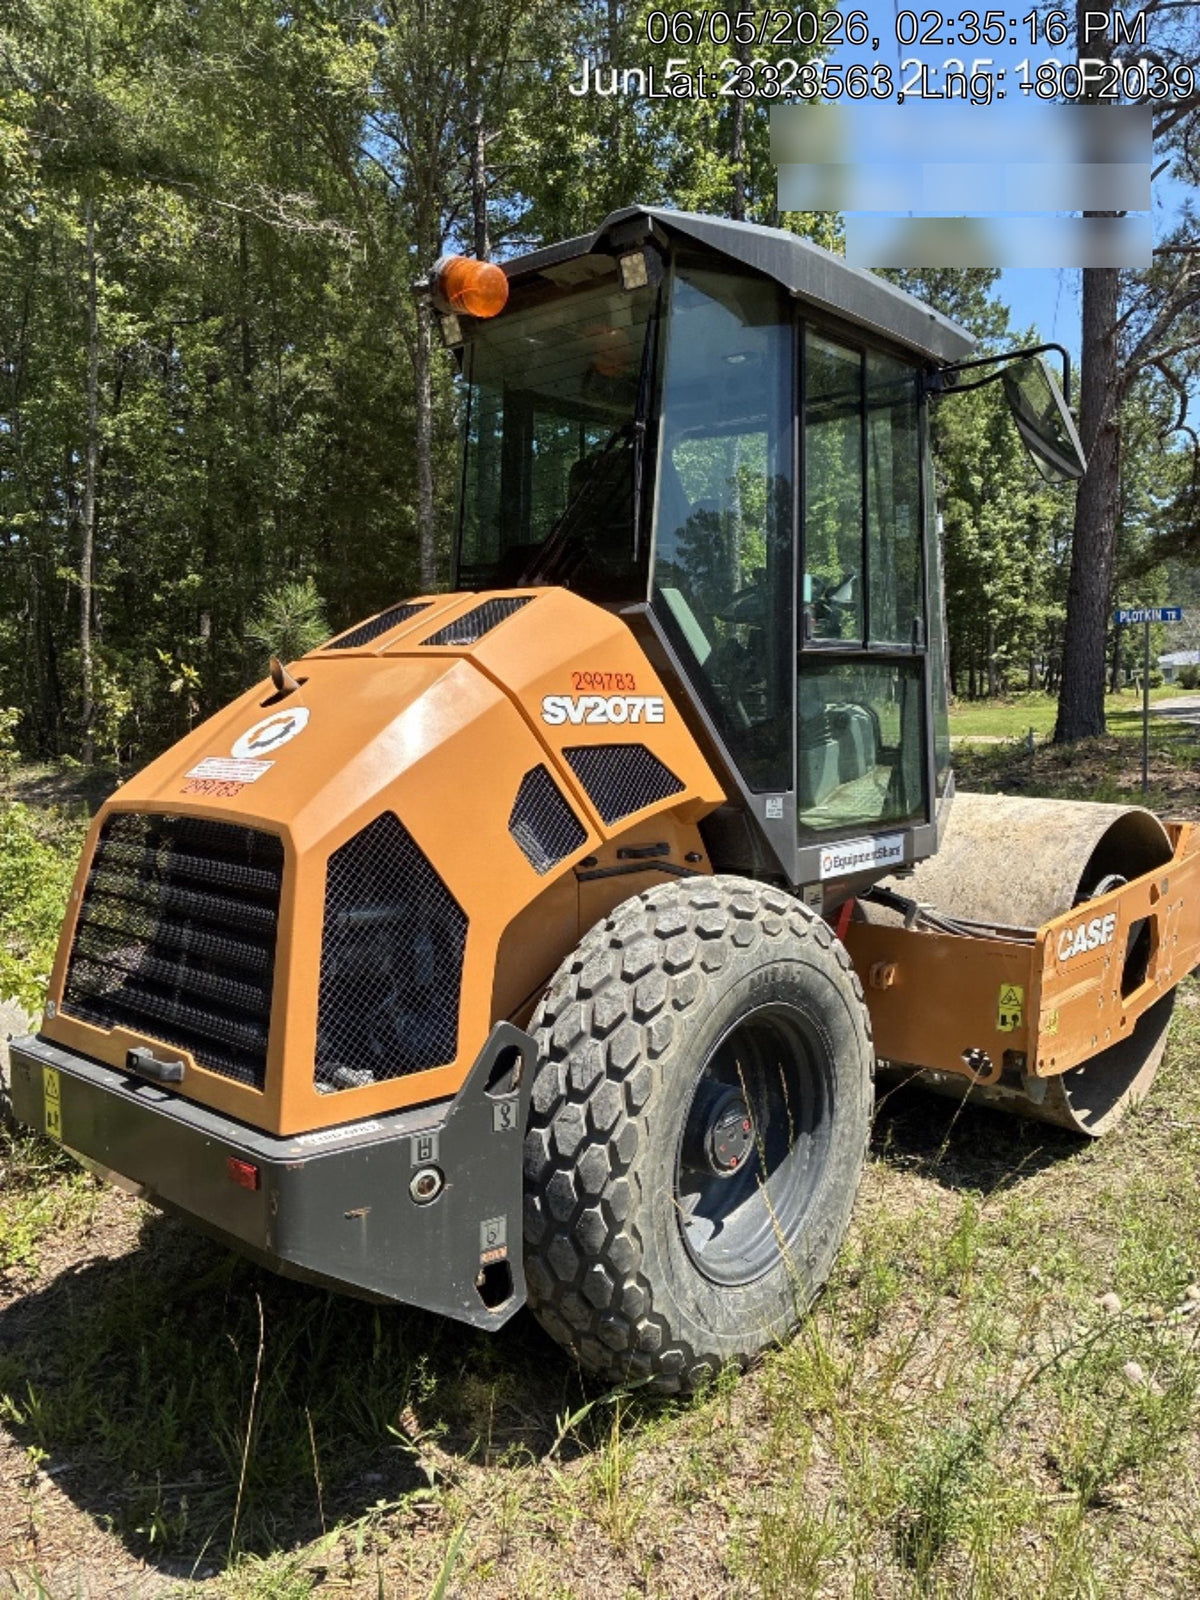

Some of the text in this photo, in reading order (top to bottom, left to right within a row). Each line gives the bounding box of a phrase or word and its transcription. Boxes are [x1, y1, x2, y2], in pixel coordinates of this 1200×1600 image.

[1119, 609, 1162, 623] PLOTKIN
[571, 671, 636, 691] 299783
[541, 695, 665, 725] SV207E
